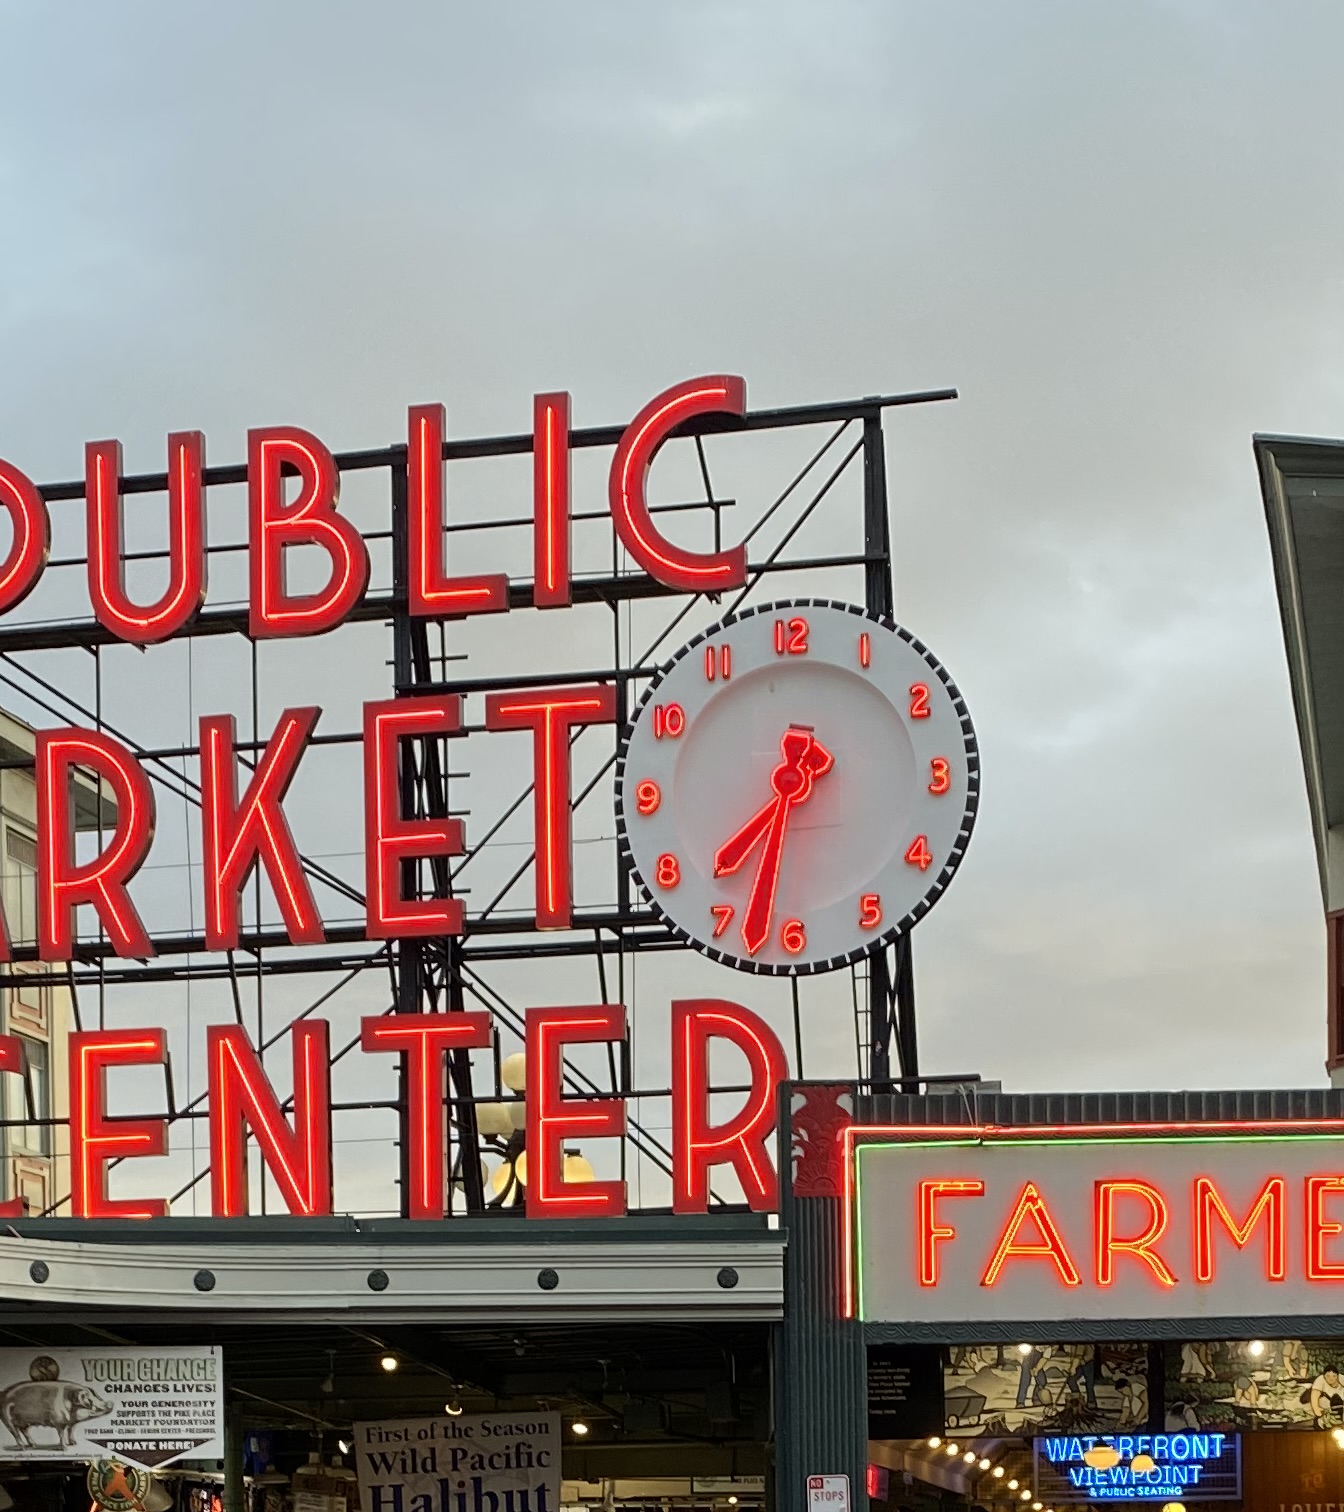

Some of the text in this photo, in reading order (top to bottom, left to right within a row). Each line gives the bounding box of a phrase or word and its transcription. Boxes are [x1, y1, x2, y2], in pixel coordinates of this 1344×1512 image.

[773, 617, 810, 655] 12
[859, 632, 870, 669] 1
[703, 644, 731, 682] 11
[909, 682, 931, 719] 2
[653, 702, 685, 739] 10
[927, 756, 951, 795] 3
[635, 779, 661, 816] 9
[904, 834, 933, 871] 4
[656, 853, 681, 889] 8
[710, 905, 735, 938] 7
[858, 894, 881, 929] 5
[781, 920, 807, 954] 6
[81, 1357, 217, 1382] YOUR CHANGE
[104, 1384, 217, 1393] CHANGES LIVES!
[121, 1400, 216, 1408] YOUR GENEROSITY
[116, 1410, 156, 1418] SUPPORTS
[153, 1418, 216, 1426] FOUNDATION
[107, 1441, 195, 1450] DONATE HERE!
[365, 1420, 550, 1443] First of the Season
[366, 1441, 551, 1476] Wild Pacific
[810, 1479, 823, 1488] NO
[1070, 1465, 1203, 1487] VIEWPOINT
[1099, 1487, 1135, 1497] PUBLIC
[1137, 1486, 1183, 1496] SEATING
[814, 1490, 844, 1501] STOPS
